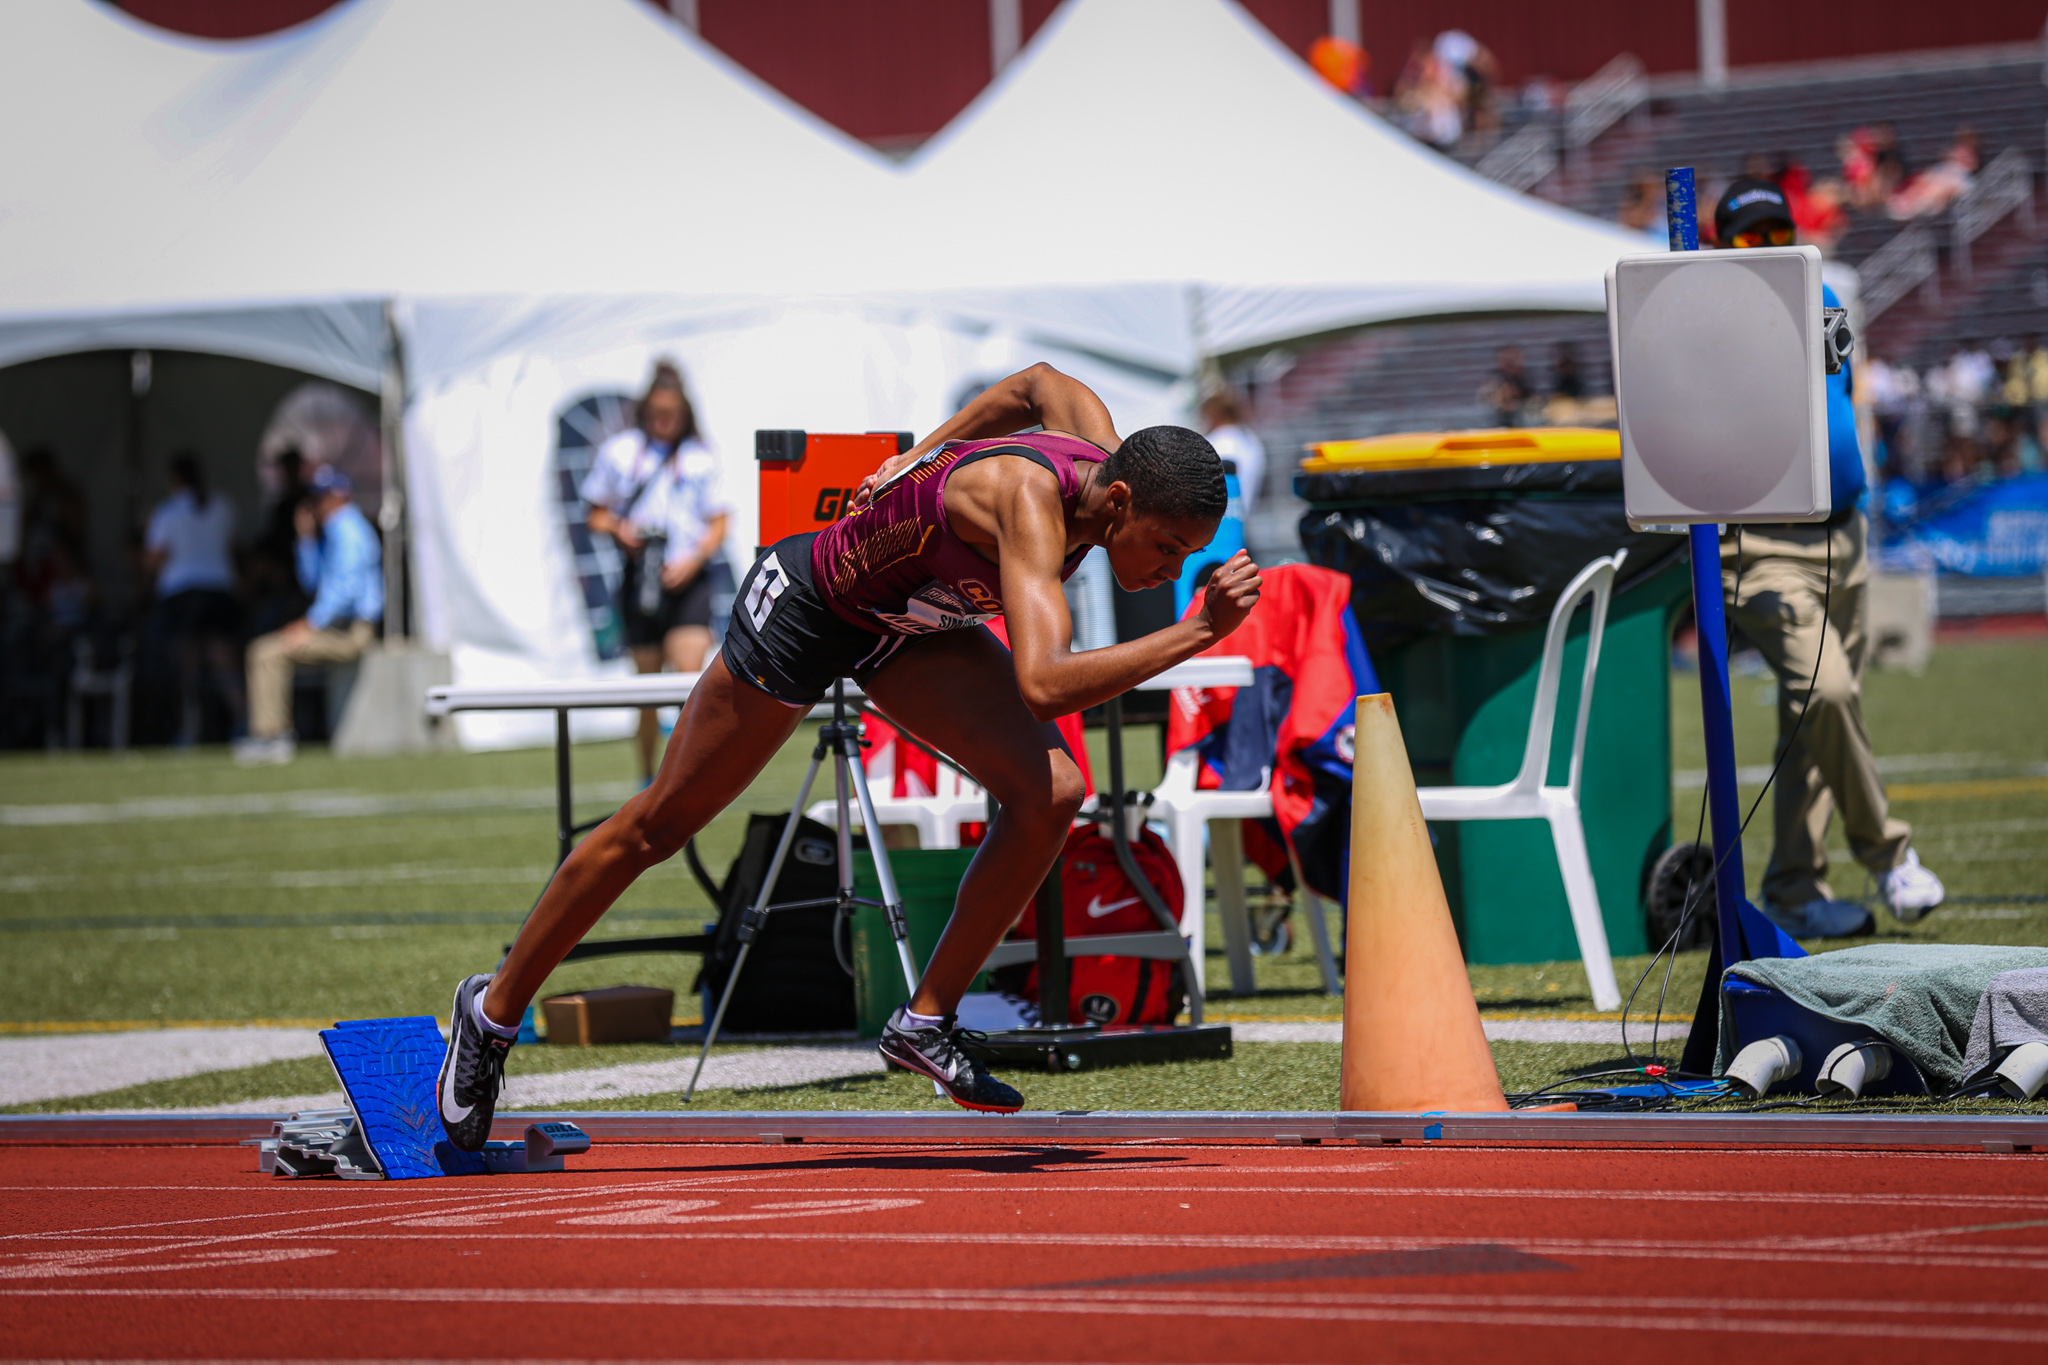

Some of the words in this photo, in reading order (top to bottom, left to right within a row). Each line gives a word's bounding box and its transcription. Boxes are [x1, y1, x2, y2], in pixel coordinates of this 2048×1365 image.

[753, 569, 779, 618] 1
[361, 1053, 420, 1077] GILL
[543, 1124, 578, 1133] GILL
